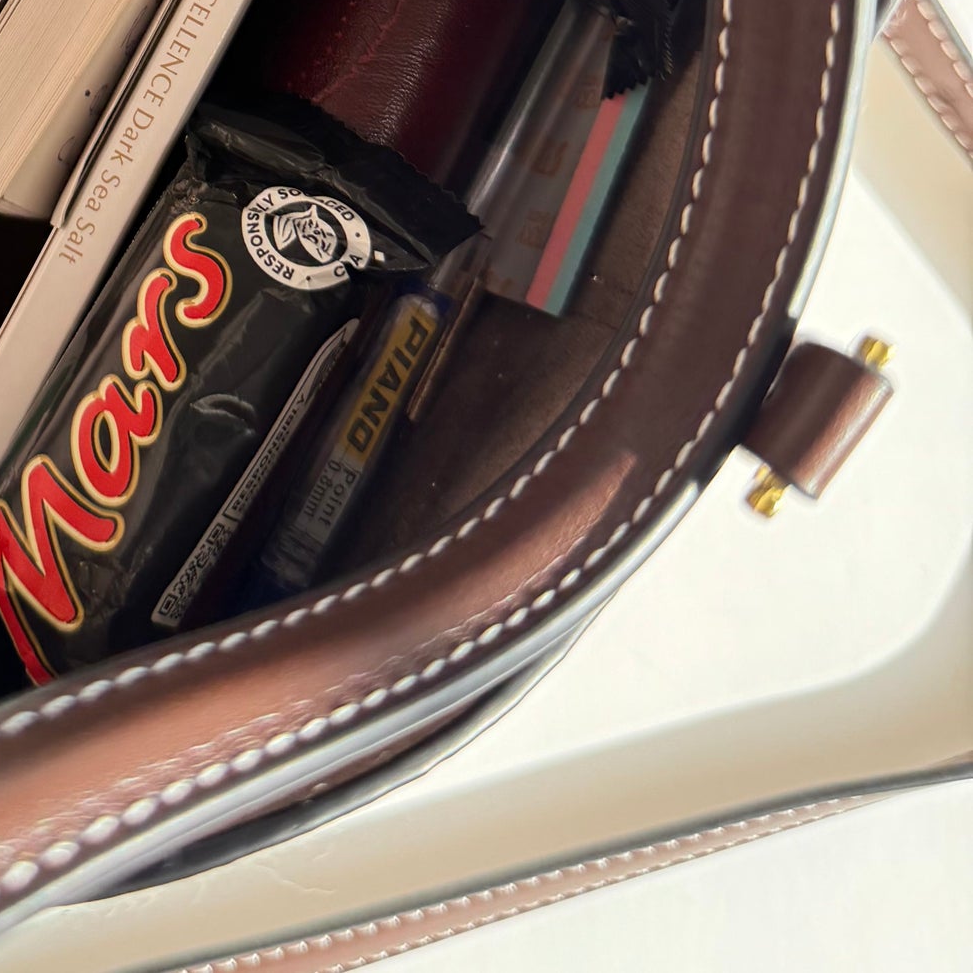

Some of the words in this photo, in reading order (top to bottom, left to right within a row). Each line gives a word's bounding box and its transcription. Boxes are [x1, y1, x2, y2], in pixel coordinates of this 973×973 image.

[109, 107, 155, 166] Dark
[84, 169, 121, 213] Sea
[58, 216, 96, 265] Salt
[347, 316, 429, 454] PIANO
[321, 468, 358, 526] Point
